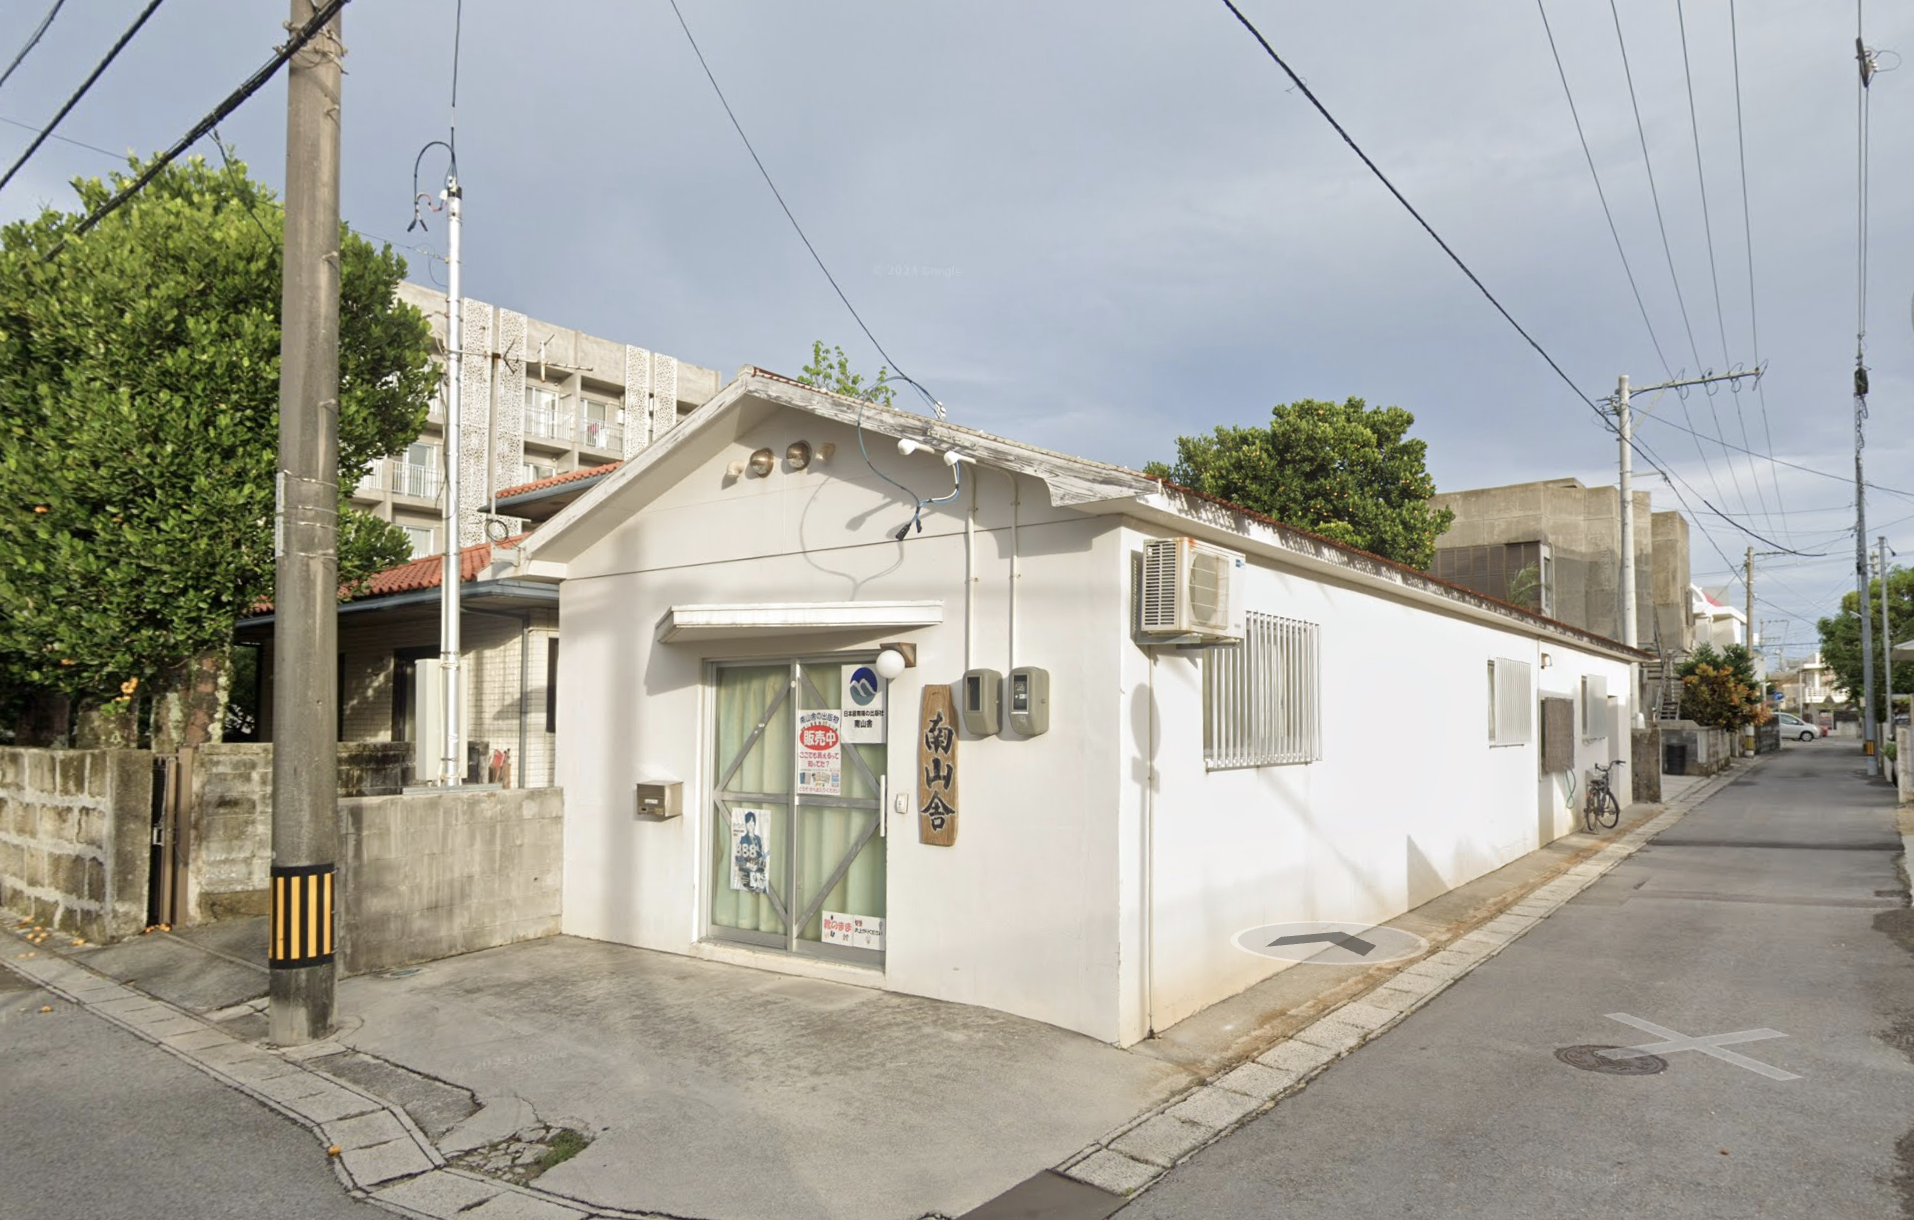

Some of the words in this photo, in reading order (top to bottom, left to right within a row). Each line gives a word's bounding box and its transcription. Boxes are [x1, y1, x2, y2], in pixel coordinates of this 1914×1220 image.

[804, 729, 837, 746] 販売中
[920, 710, 955, 833] 南山舎
